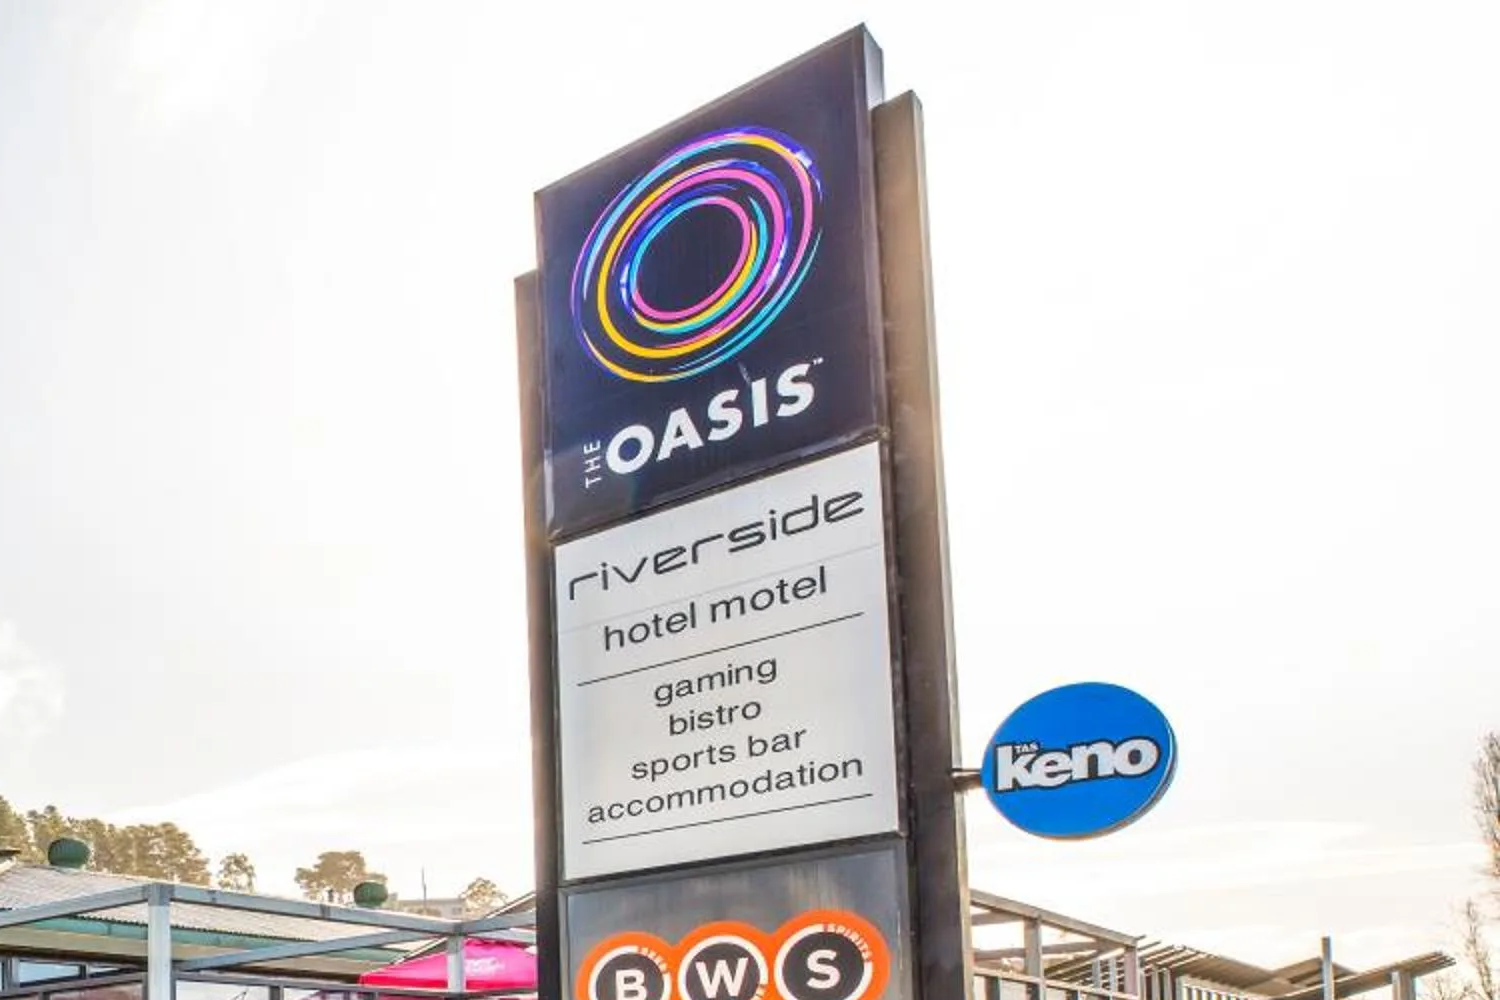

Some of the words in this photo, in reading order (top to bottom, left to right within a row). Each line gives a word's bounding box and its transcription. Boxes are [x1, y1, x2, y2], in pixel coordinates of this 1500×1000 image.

[583, 439, 602, 489] THE
[605, 363, 816, 475] OASIS
[568, 490, 865, 601] riverside
[603, 601, 697, 652] hotel
[709, 565, 828, 624] motel
[653, 656, 779, 708] gaming
[668, 700, 763, 737] bistro
[631, 740, 737, 783] sports
[747, 728, 808, 758] bar
[995, 738, 1161, 792] keno
[587, 756, 864, 825] accommodation
